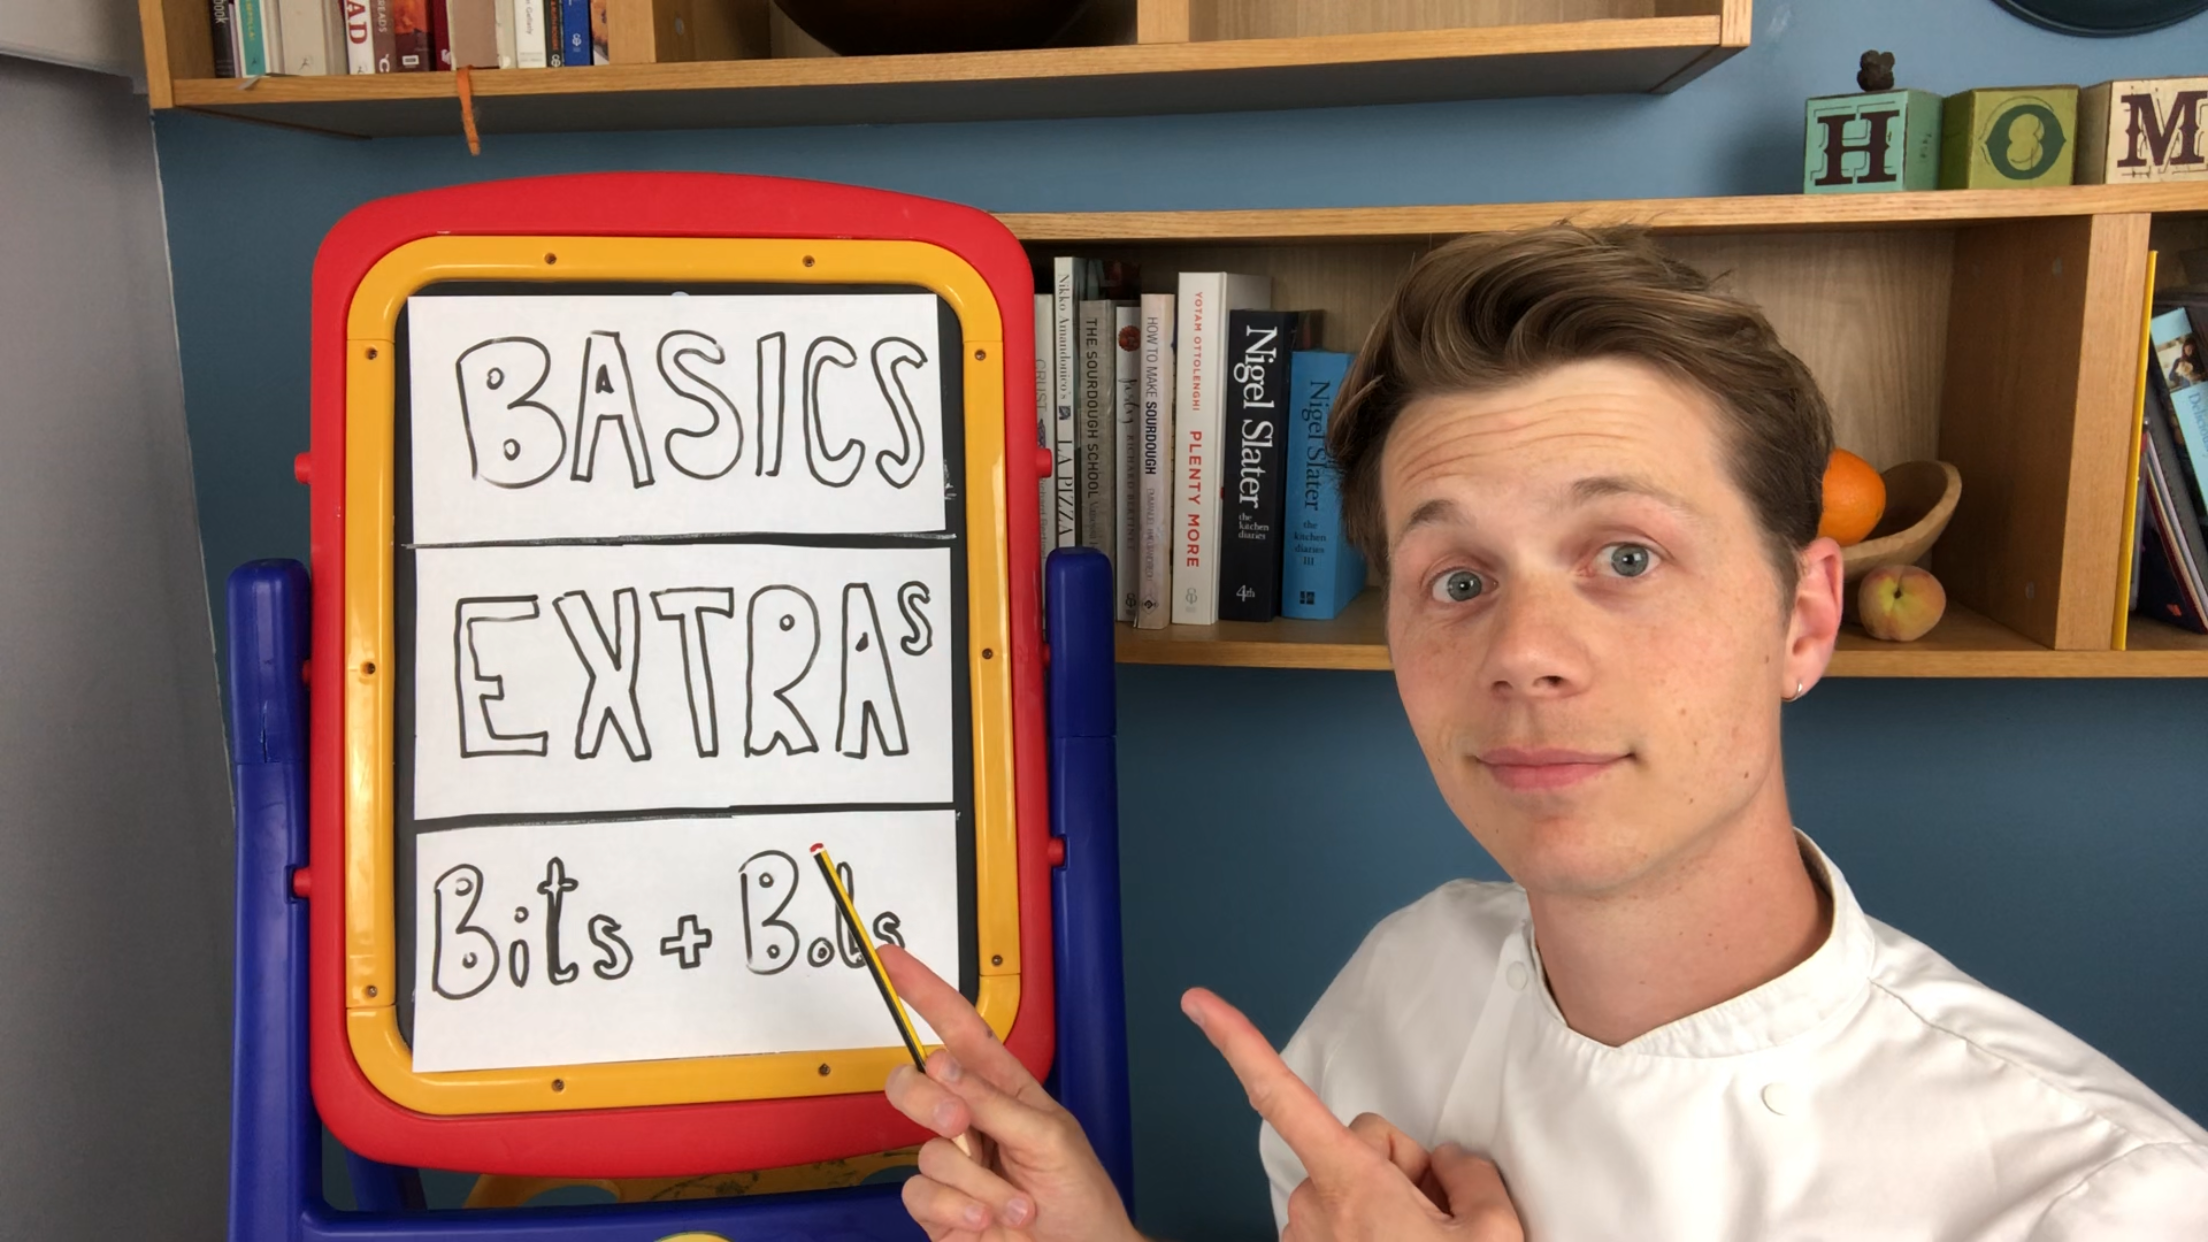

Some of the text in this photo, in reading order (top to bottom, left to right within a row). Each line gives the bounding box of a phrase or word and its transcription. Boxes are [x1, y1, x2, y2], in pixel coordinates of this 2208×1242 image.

[1058, 274, 1070, 311] Nikko
[1086, 318, 1098, 346] THE
[1086, 351, 1099, 438] SOURDOUGH
[1192, 292, 1203, 411] YOTAM OTTOLENGHI
[456, 330, 927, 488] BASICS
[1144, 317, 1159, 475] HOW TO MAKE SOURDOUGH
[1233, 326, 1277, 509] Nigel Slater
[1057, 440, 1074, 535] LA PIZZA
[1087, 444, 1099, 499] SCHOOL
[1127, 435, 1135, 488] RICHARD
[1302, 380, 1330, 511] Nigel Slater
[1186, 430, 1203, 567] PLENTY MORE
[1238, 513, 1252, 522] the
[1238, 522, 1270, 531] kitchen
[1238, 530, 1266, 540] diaries
[1294, 532, 1327, 542] kitchen
[1303, 520, 1318, 529] the
[453, 580, 933, 762] EXTRAS
[432, 856, 634, 1000] Bits
